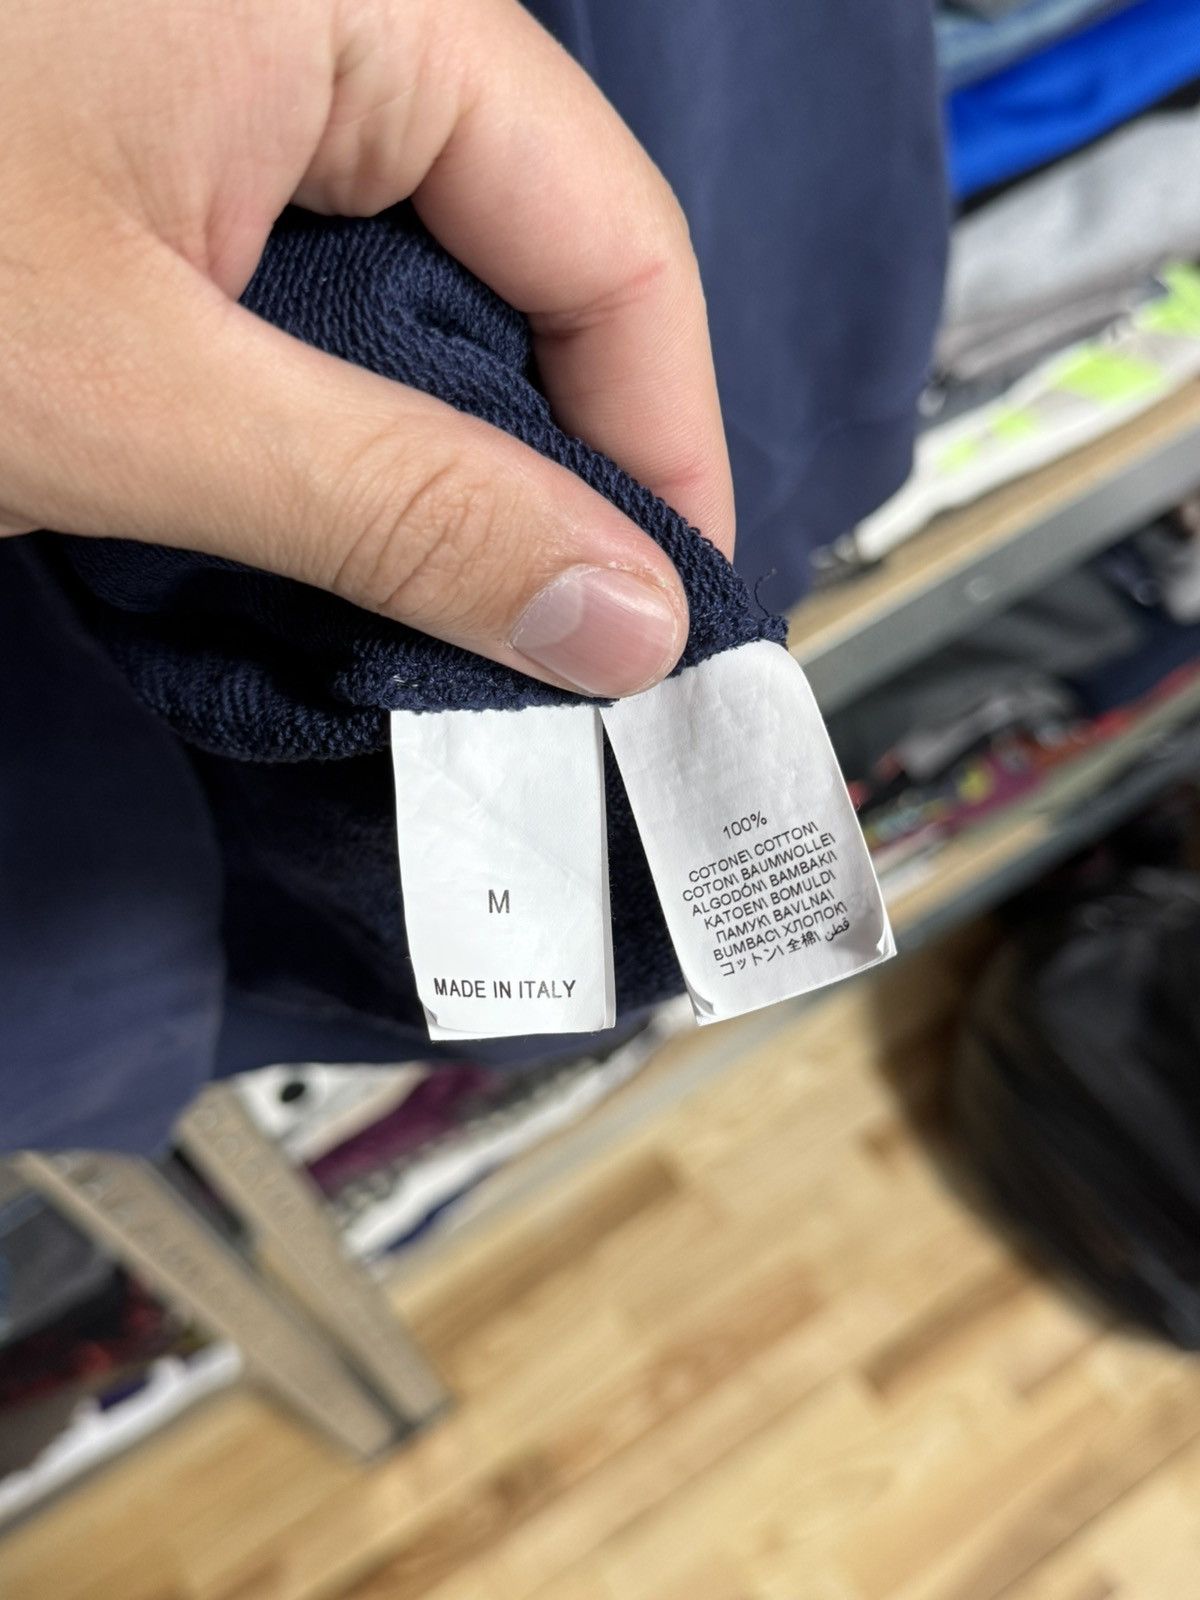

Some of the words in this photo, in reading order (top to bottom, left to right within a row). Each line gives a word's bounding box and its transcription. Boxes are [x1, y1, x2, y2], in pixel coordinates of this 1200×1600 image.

[723, 811, 768, 839] 100%
[488, 889, 510, 914] M
[433, 977, 487, 999] MADE
[493, 980, 512, 999] IN
[518, 979, 577, 999] ITALY
